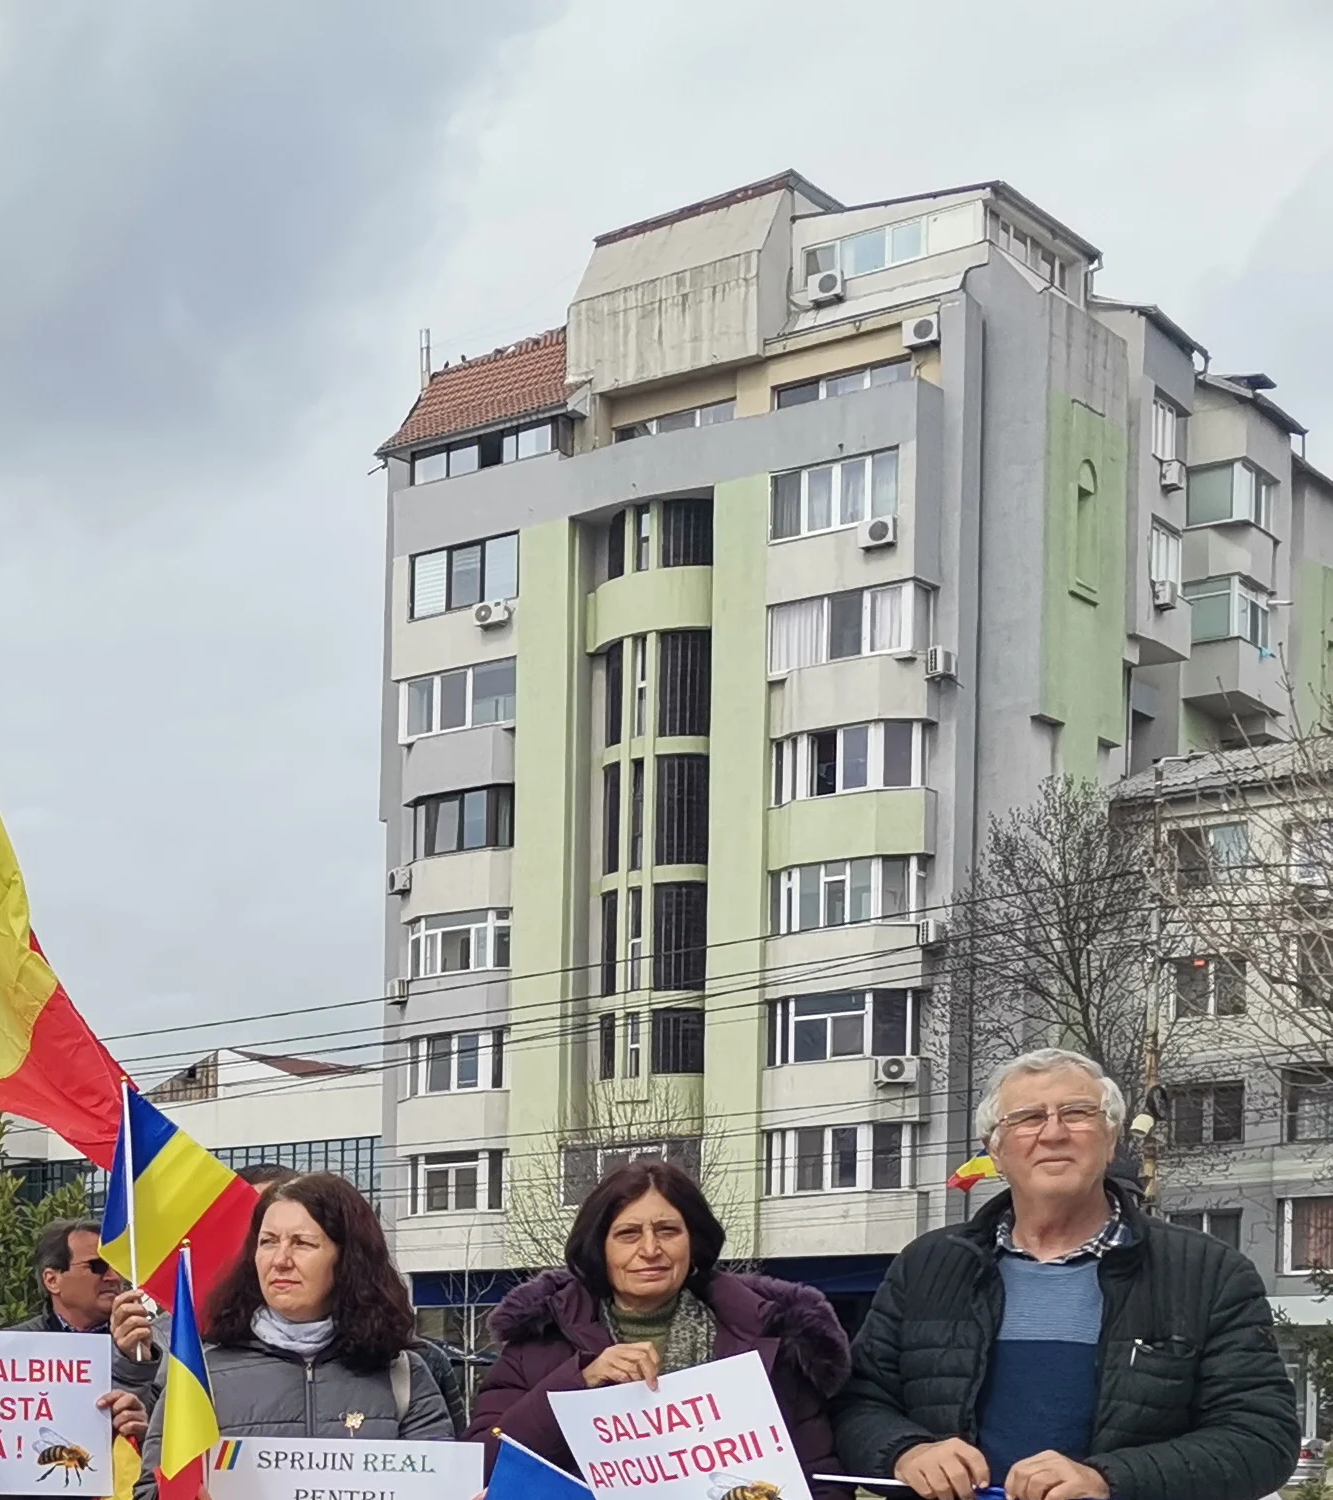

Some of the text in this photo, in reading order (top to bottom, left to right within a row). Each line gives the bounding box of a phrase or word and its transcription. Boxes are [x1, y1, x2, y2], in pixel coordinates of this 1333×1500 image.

[256, 1450, 436, 1474] SPRIJIN REAL
[588, 1431, 764, 1489] APICULTORII
